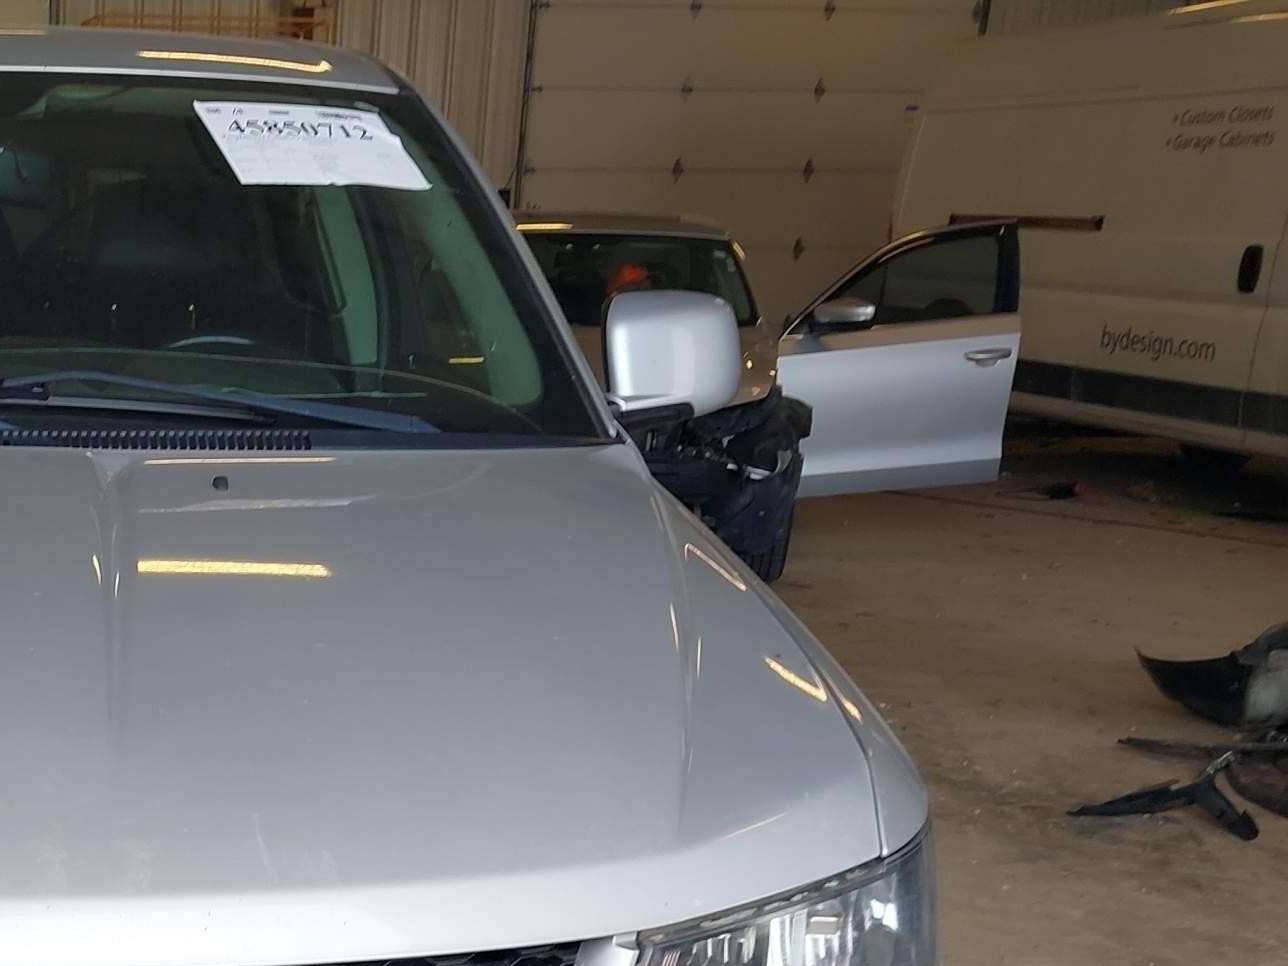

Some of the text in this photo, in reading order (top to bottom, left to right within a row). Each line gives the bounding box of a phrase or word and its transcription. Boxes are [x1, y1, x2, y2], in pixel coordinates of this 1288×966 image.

[1179, 105, 1273, 125] Custom Closets
[1172, 130, 1273, 153] Garage Cabinets
[1100, 323, 1217, 362] bydesign.com
